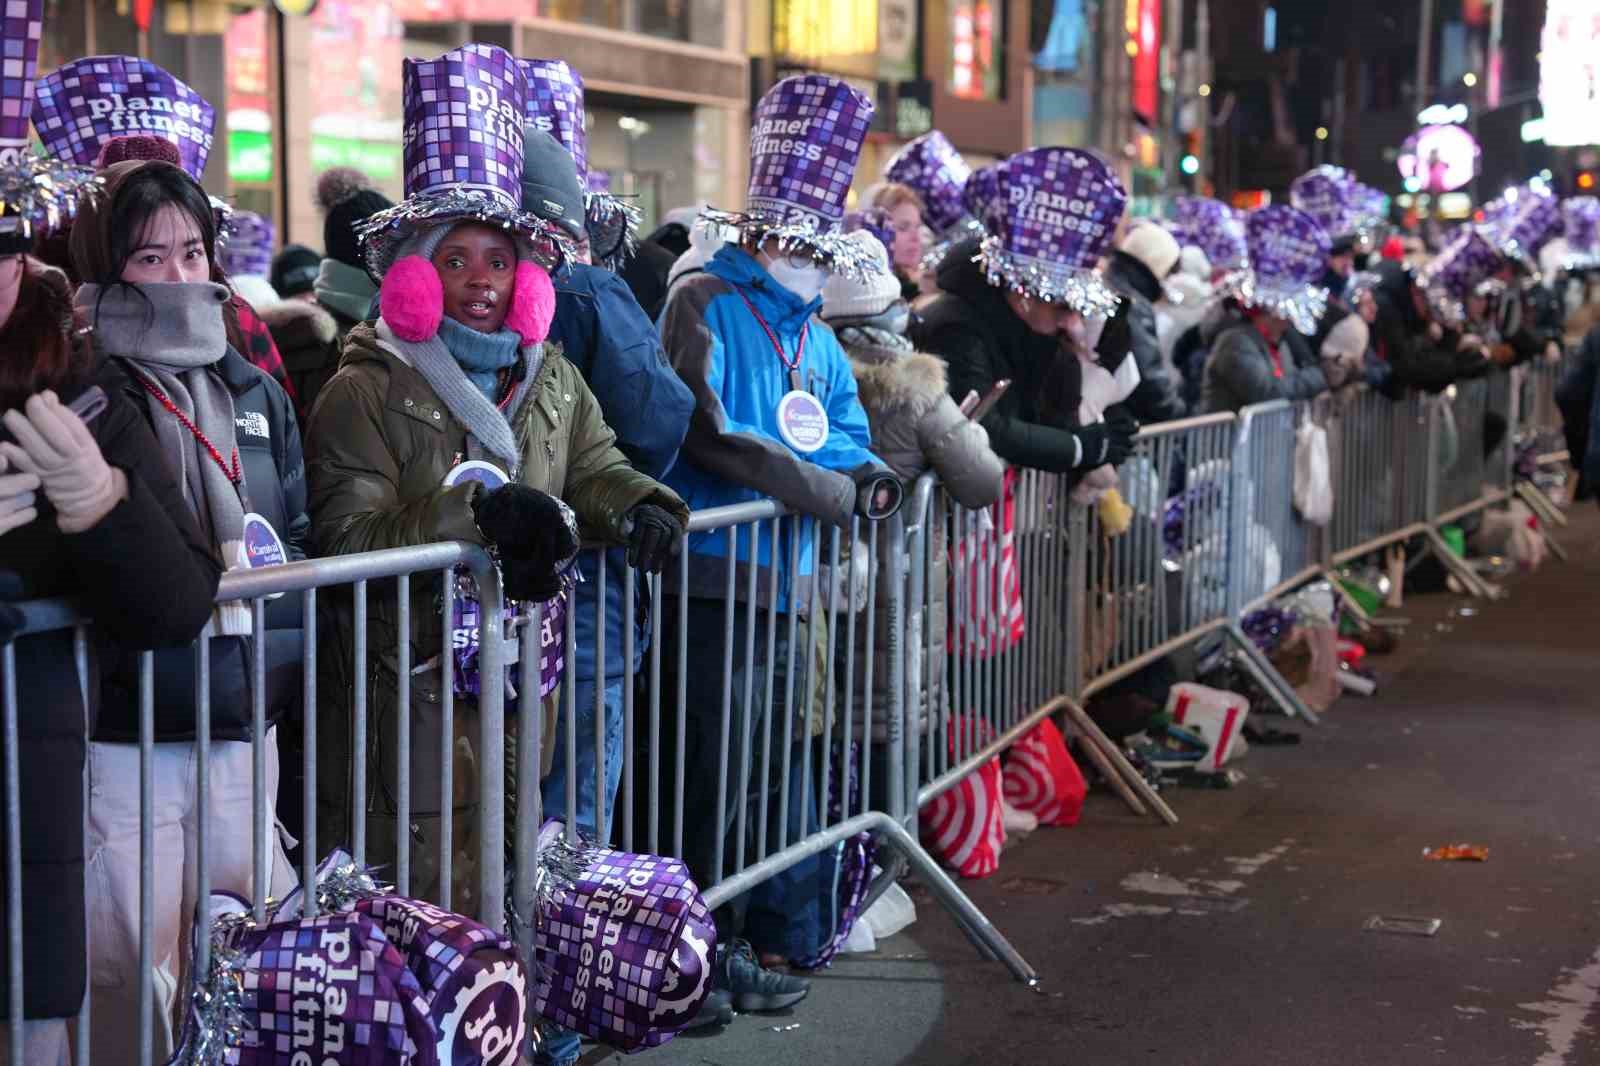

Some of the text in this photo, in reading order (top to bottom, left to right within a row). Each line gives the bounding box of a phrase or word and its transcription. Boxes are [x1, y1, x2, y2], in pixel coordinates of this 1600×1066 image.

[88, 93, 203, 122] planet
[110, 111, 214, 151] fitness
[1009, 183, 1096, 217] planet
[1016, 201, 1105, 237] fitness
[235, 418, 260, 429] NORTH
[244, 411, 260, 420] THE
[245, 426, 265, 437] FACE
[571, 875, 626, 1011] fitness
[595, 868, 654, 992] planet
